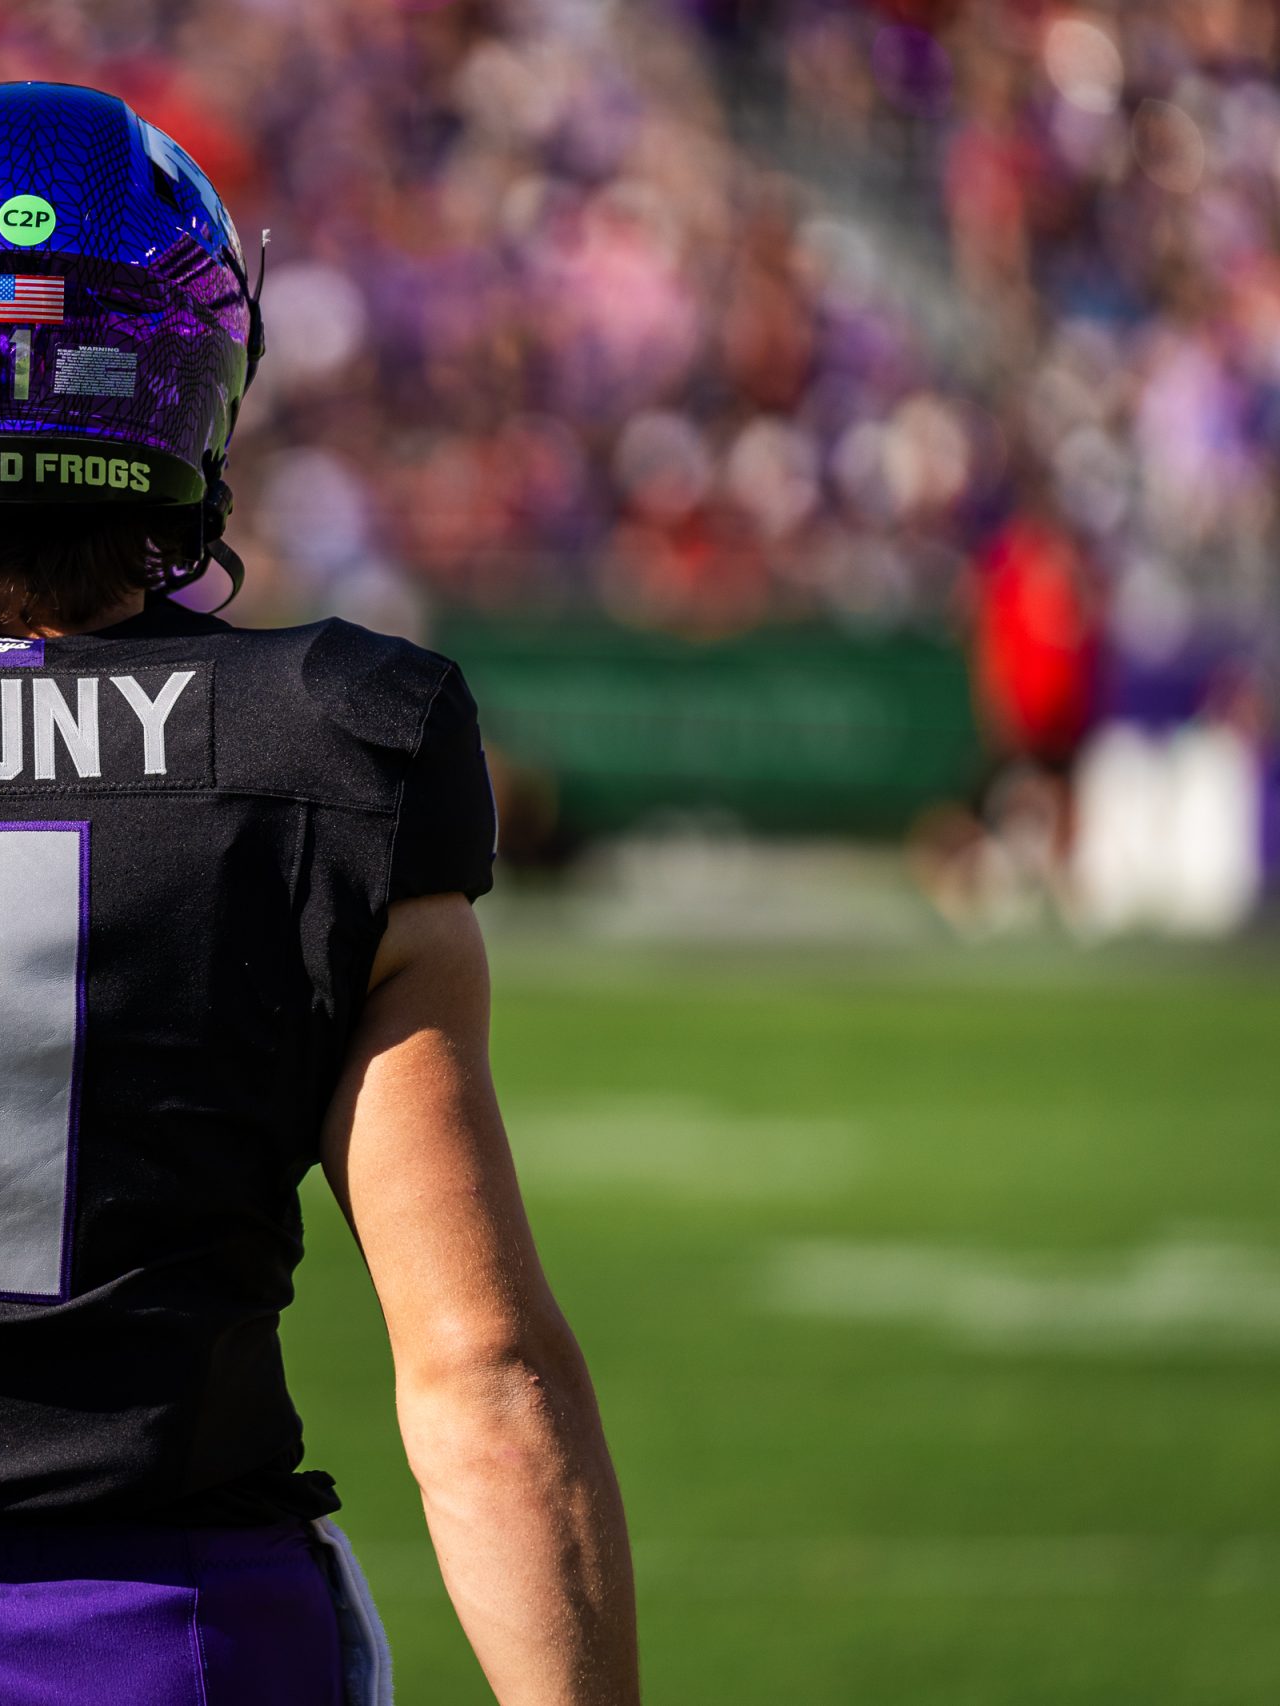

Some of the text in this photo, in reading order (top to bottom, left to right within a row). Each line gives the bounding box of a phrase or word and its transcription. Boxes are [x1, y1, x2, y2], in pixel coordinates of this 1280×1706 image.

[3, 209, 51, 228] C2P
[78, 345, 120, 353] WARNING
[9, 329, 32, 400] 1
[35, 453, 151, 493] FROGS
